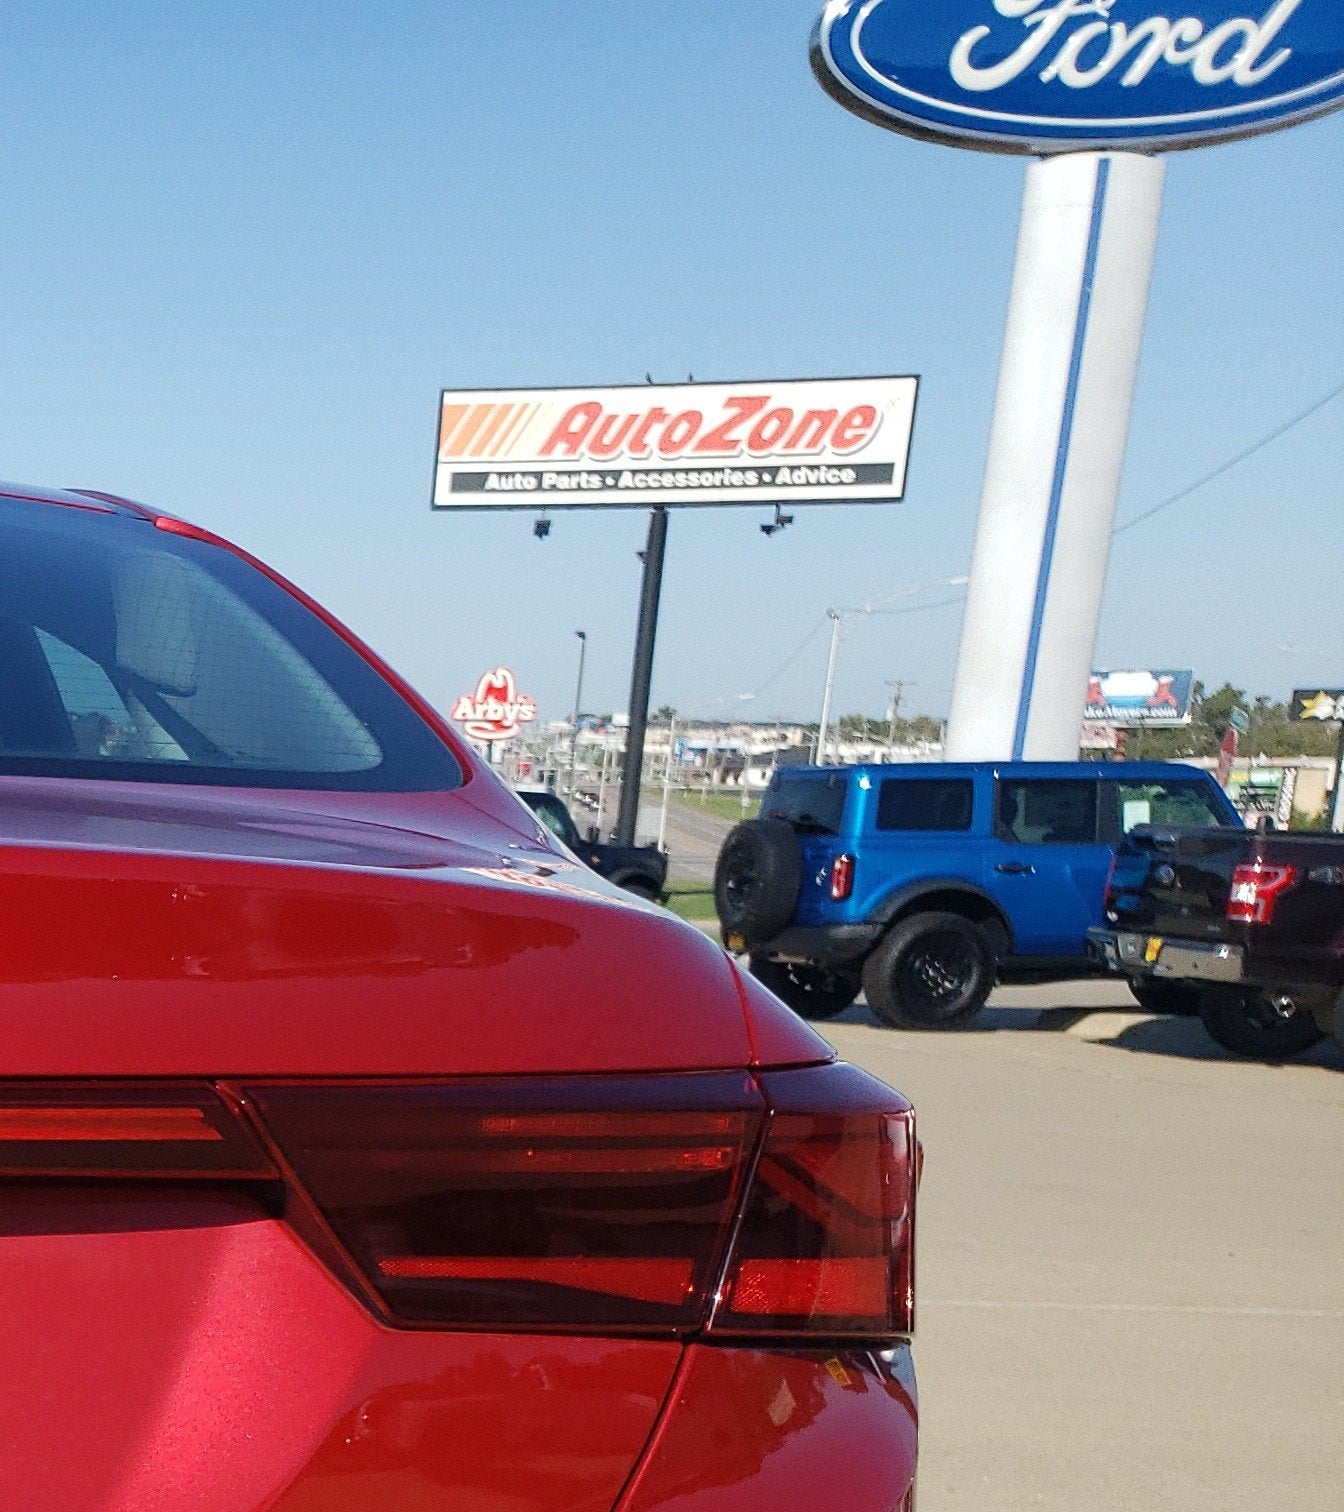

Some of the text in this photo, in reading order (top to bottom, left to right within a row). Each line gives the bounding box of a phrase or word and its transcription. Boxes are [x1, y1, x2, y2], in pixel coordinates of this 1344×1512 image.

[949, 0, 1303, 92] Ford
[537, 395, 878, 457] AutoZone
[484, 465, 857, 492] Auto Parts Accessories Advice
[452, 694, 537, 727] Arby's
